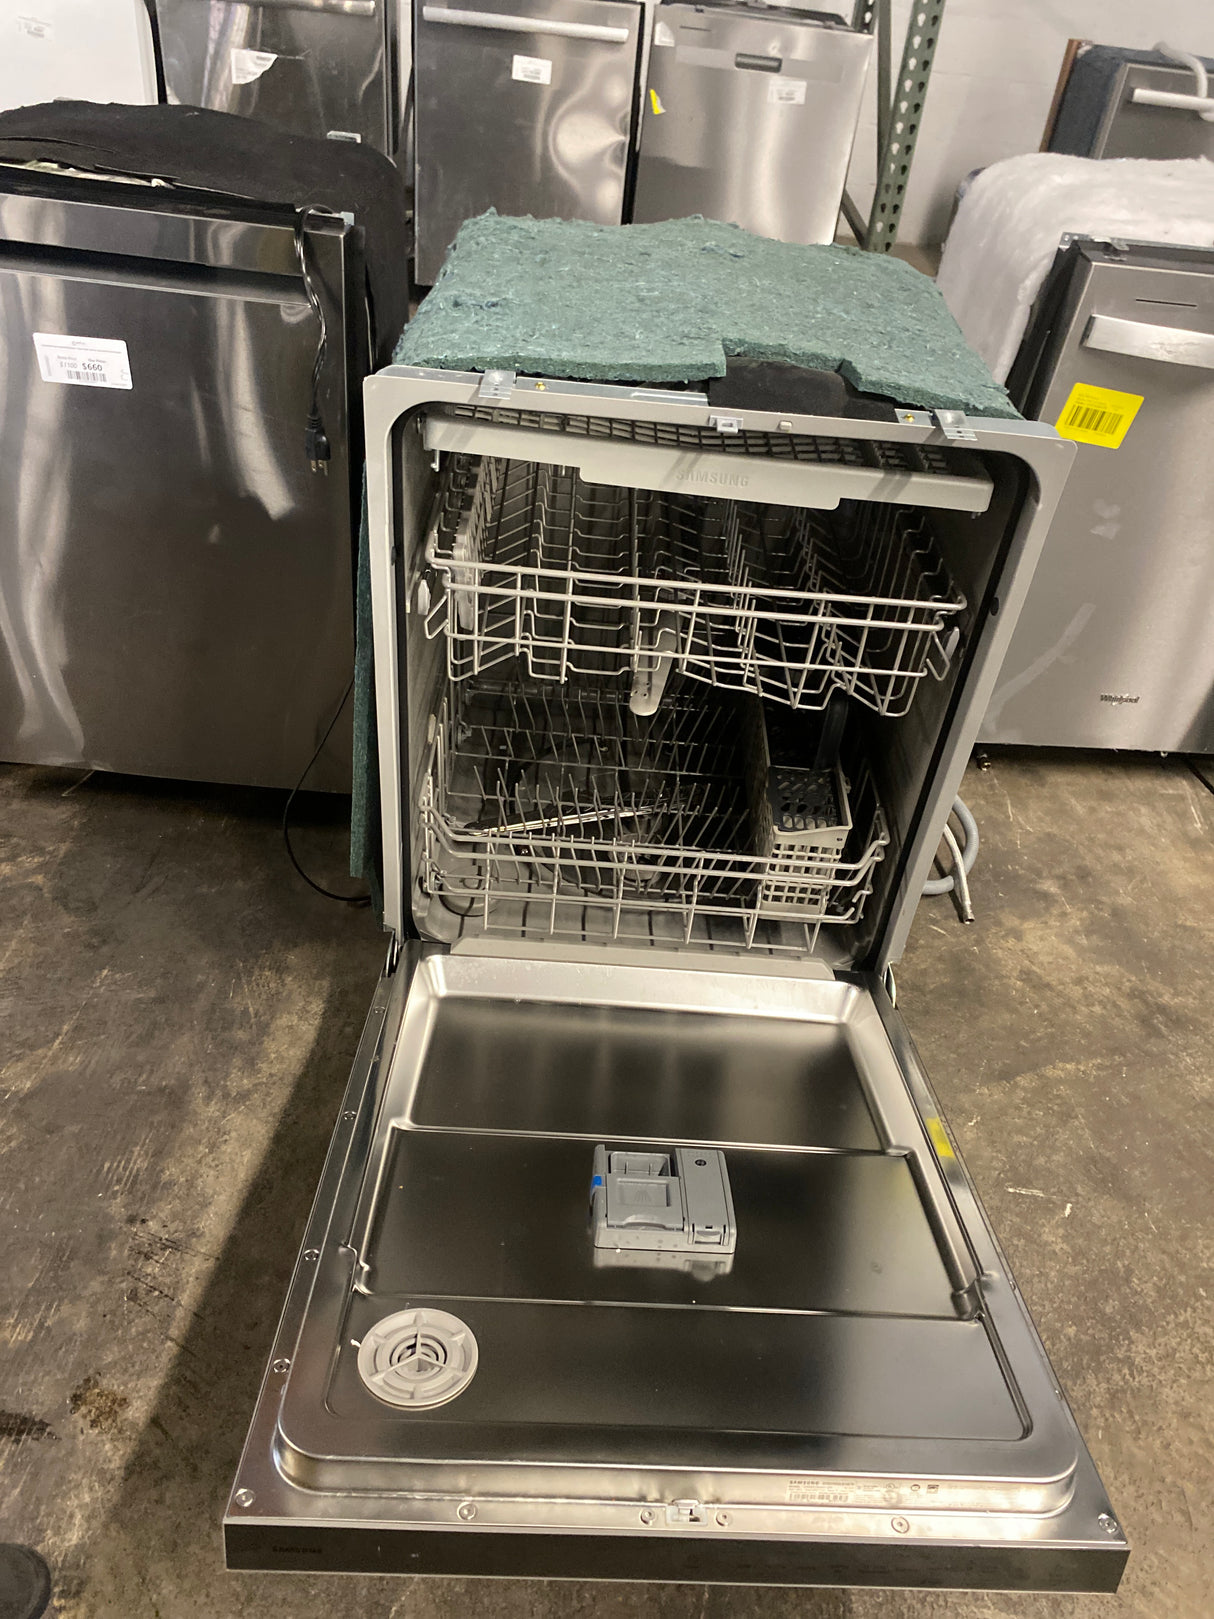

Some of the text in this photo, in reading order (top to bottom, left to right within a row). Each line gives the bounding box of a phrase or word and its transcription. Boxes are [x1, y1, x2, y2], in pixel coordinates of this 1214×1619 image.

[82, 363, 103, 372] $660
[676, 470, 750, 488] SAMSUNG
[1100, 694, 1140, 704] Whirlpool
